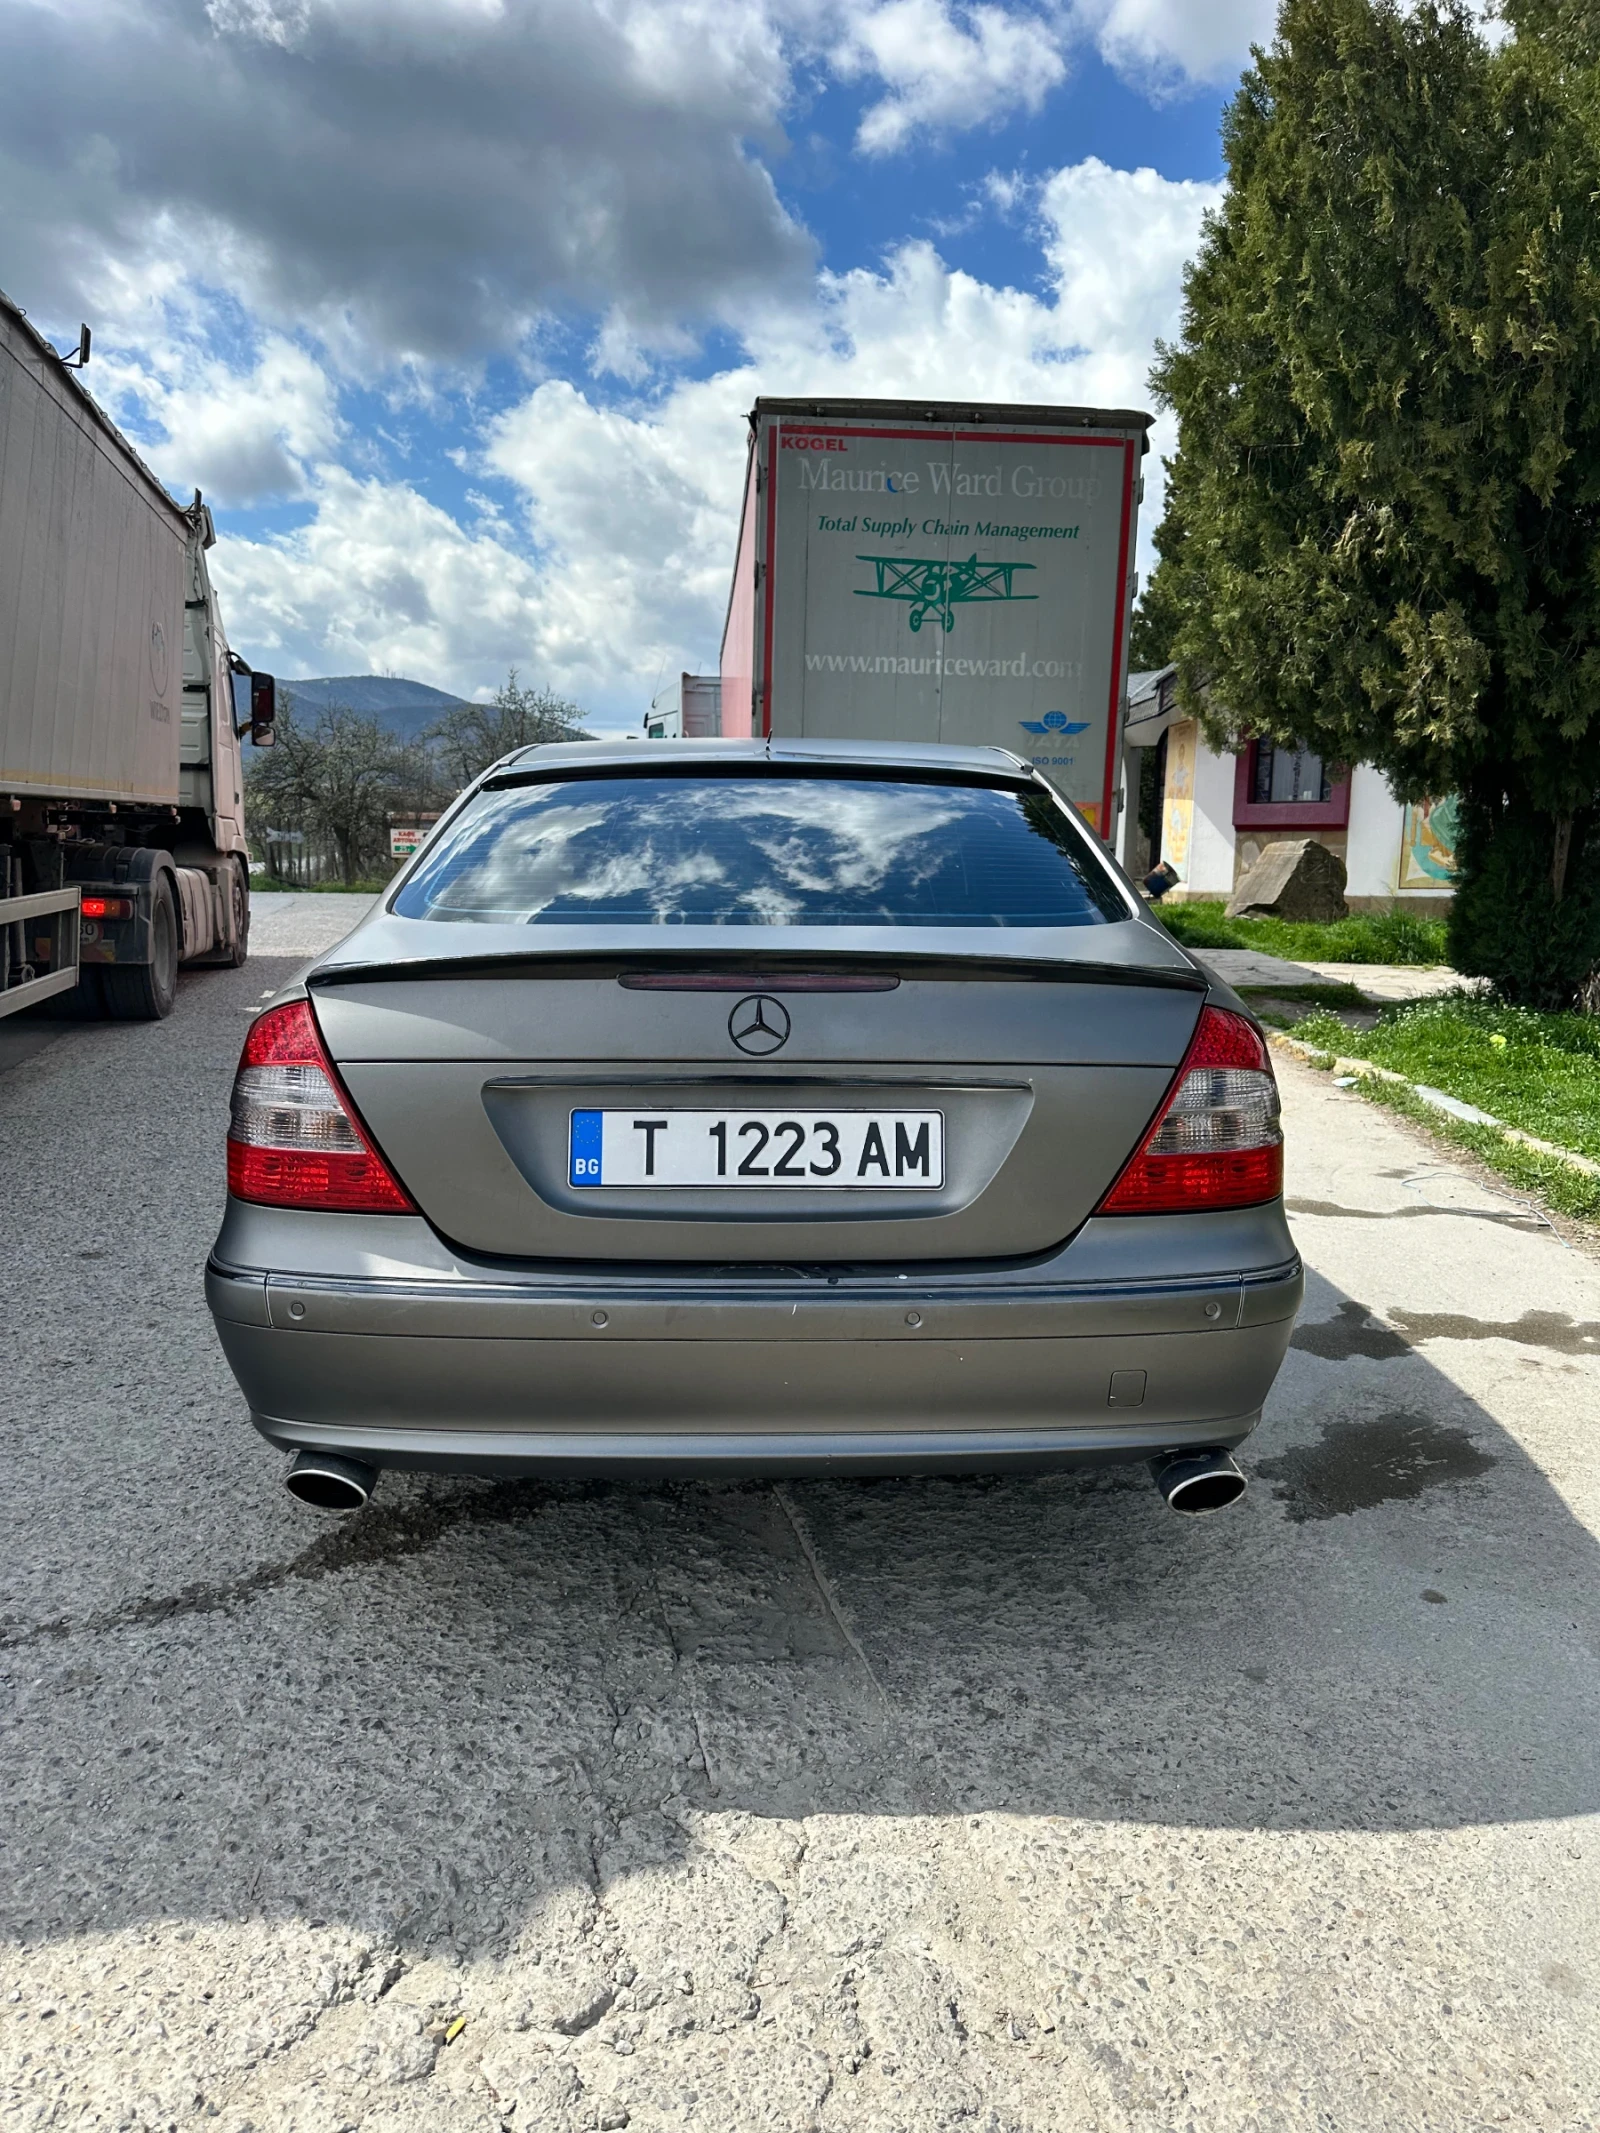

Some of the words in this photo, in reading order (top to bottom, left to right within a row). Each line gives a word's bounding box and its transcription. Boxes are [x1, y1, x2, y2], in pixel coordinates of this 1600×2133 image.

[798, 457, 919, 494] Maurice
[926, 462, 1003, 496] Ward
[1011, 465, 1101, 505] Group
[818, 515, 858, 532] Total
[861, 517, 917, 538] Supply
[922, 518, 969, 536] Chain
[974, 521, 1080, 542] Management
[804, 650, 1083, 678] www.mauriceward.com
[1032, 756, 1050, 766] ISO
[1052, 757, 1074, 766] 9001
[633, 1120, 668, 1176] T
[708, 1121, 842, 1176] 1223
[857, 1122, 930, 1177] AM
[575, 1158, 599, 1175] BG
